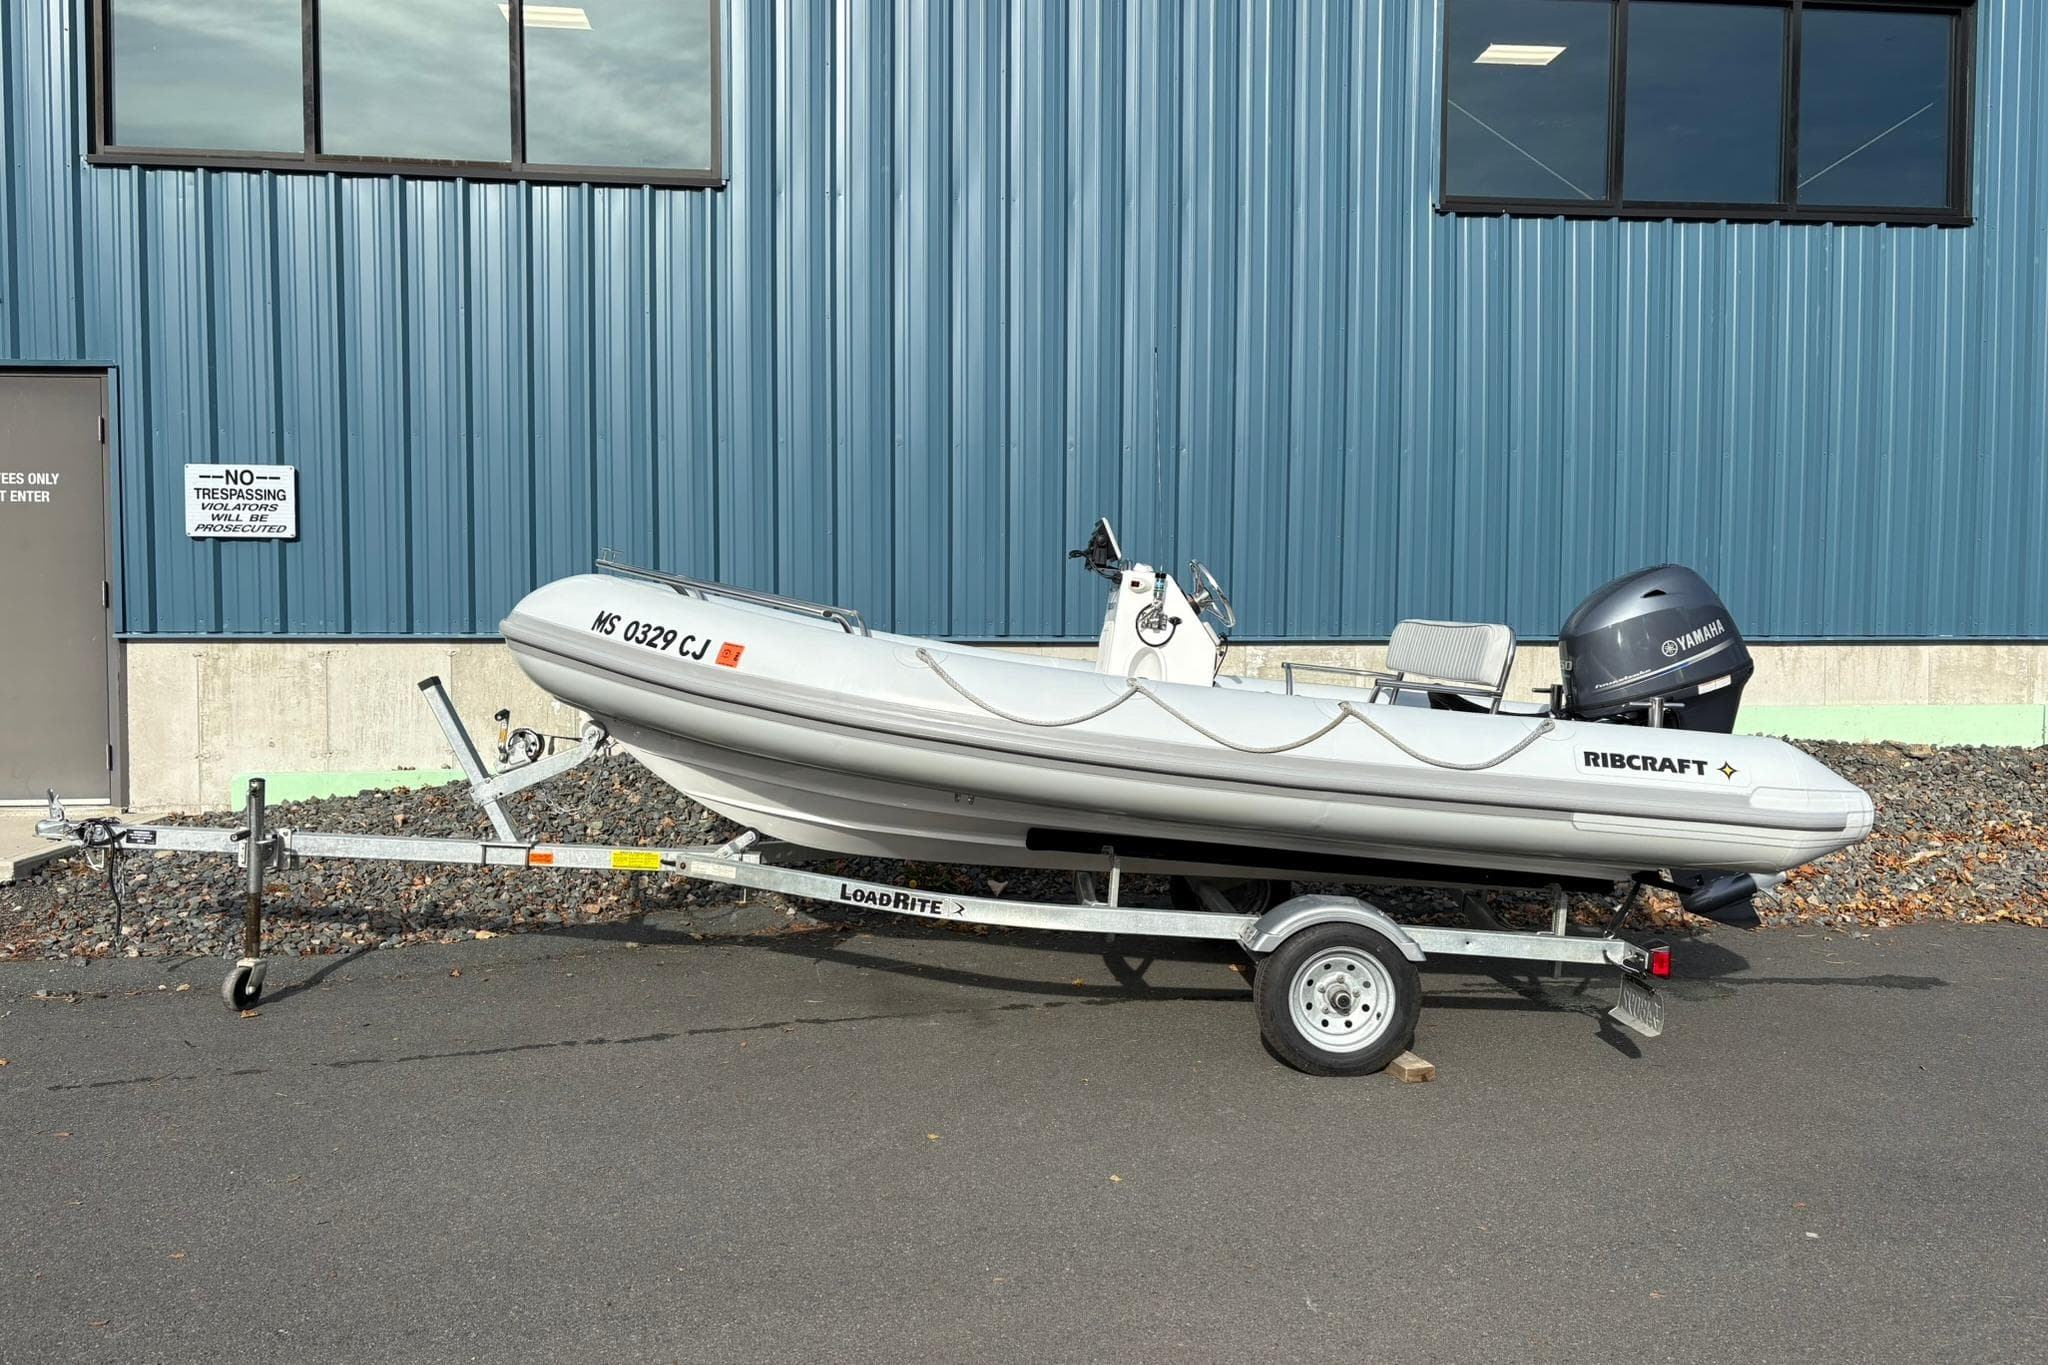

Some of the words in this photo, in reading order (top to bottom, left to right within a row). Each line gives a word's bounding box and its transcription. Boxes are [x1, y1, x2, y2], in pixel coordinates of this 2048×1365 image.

[0, 472, 25, 485] EES
[28, 472, 60, 485] ONLY
[225, 469, 254, 486] NO
[10, 490, 50, 502] ENTER
[194, 487, 287, 501] TRESPASSING
[201, 502, 279, 512] VIOLATORS
[211, 513, 243, 522] WILL
[249, 514, 269, 522] BE
[194, 524, 287, 533] PROSECUTED
[591, 610, 621, 635] MS
[623, 620, 677, 651] 0329
[679, 635, 712, 660] CJ
[1676, 619, 1725, 651] YAMAHA
[1583, 751, 1708, 776] RIBCRAFT
[840, 883, 943, 914] LOADRITE
